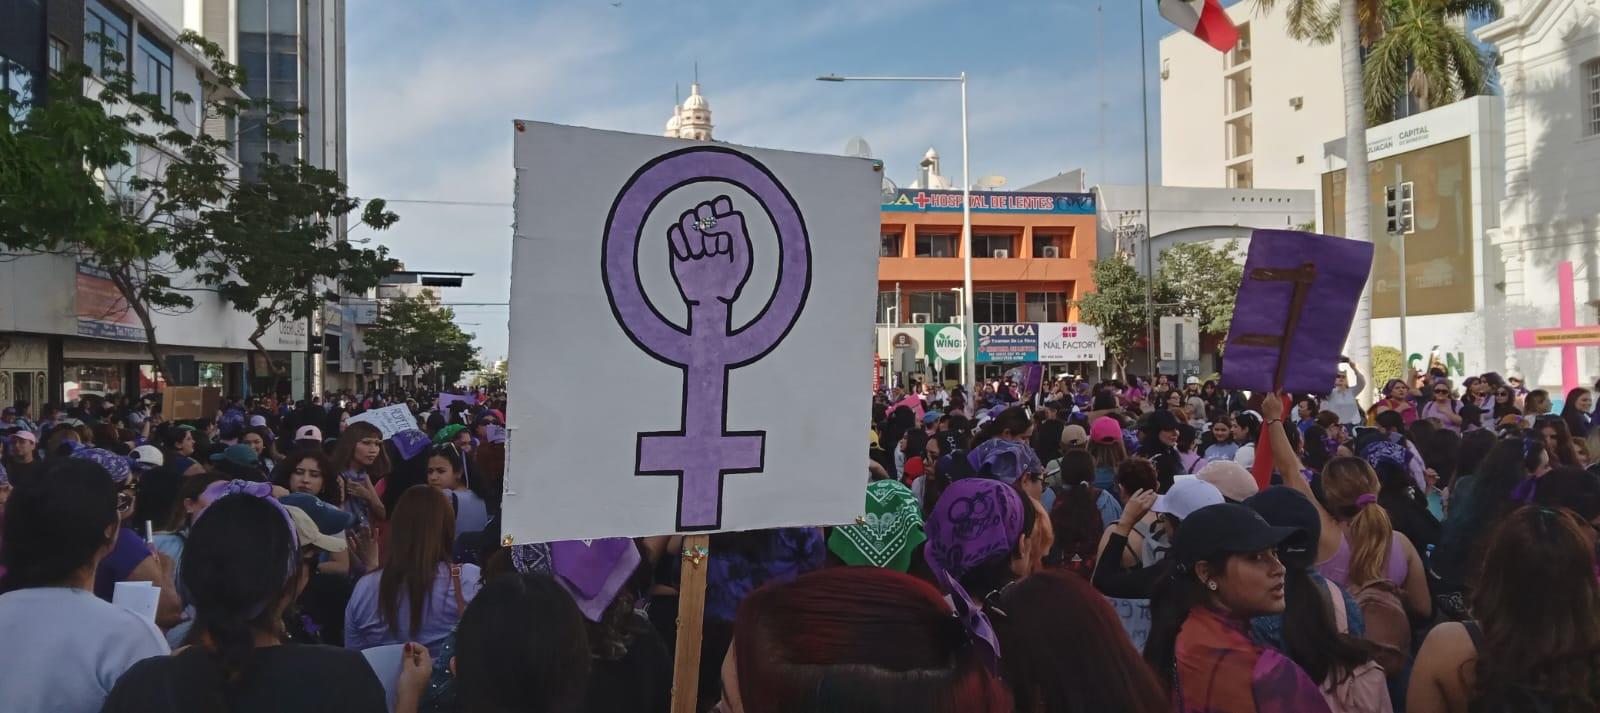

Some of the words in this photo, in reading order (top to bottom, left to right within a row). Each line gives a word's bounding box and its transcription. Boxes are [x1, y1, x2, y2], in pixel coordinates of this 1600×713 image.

[1399, 126, 1429, 139] CAPITAL
[931, 194, 989, 209] HOSPTAL
[991, 195, 1007, 209] DE
[1008, 196, 1055, 211] LENTES
[978, 324, 1036, 336] OPTICA
[1043, 341, 1061, 350] NAIL
[1062, 340, 1097, 349] FACTORY
